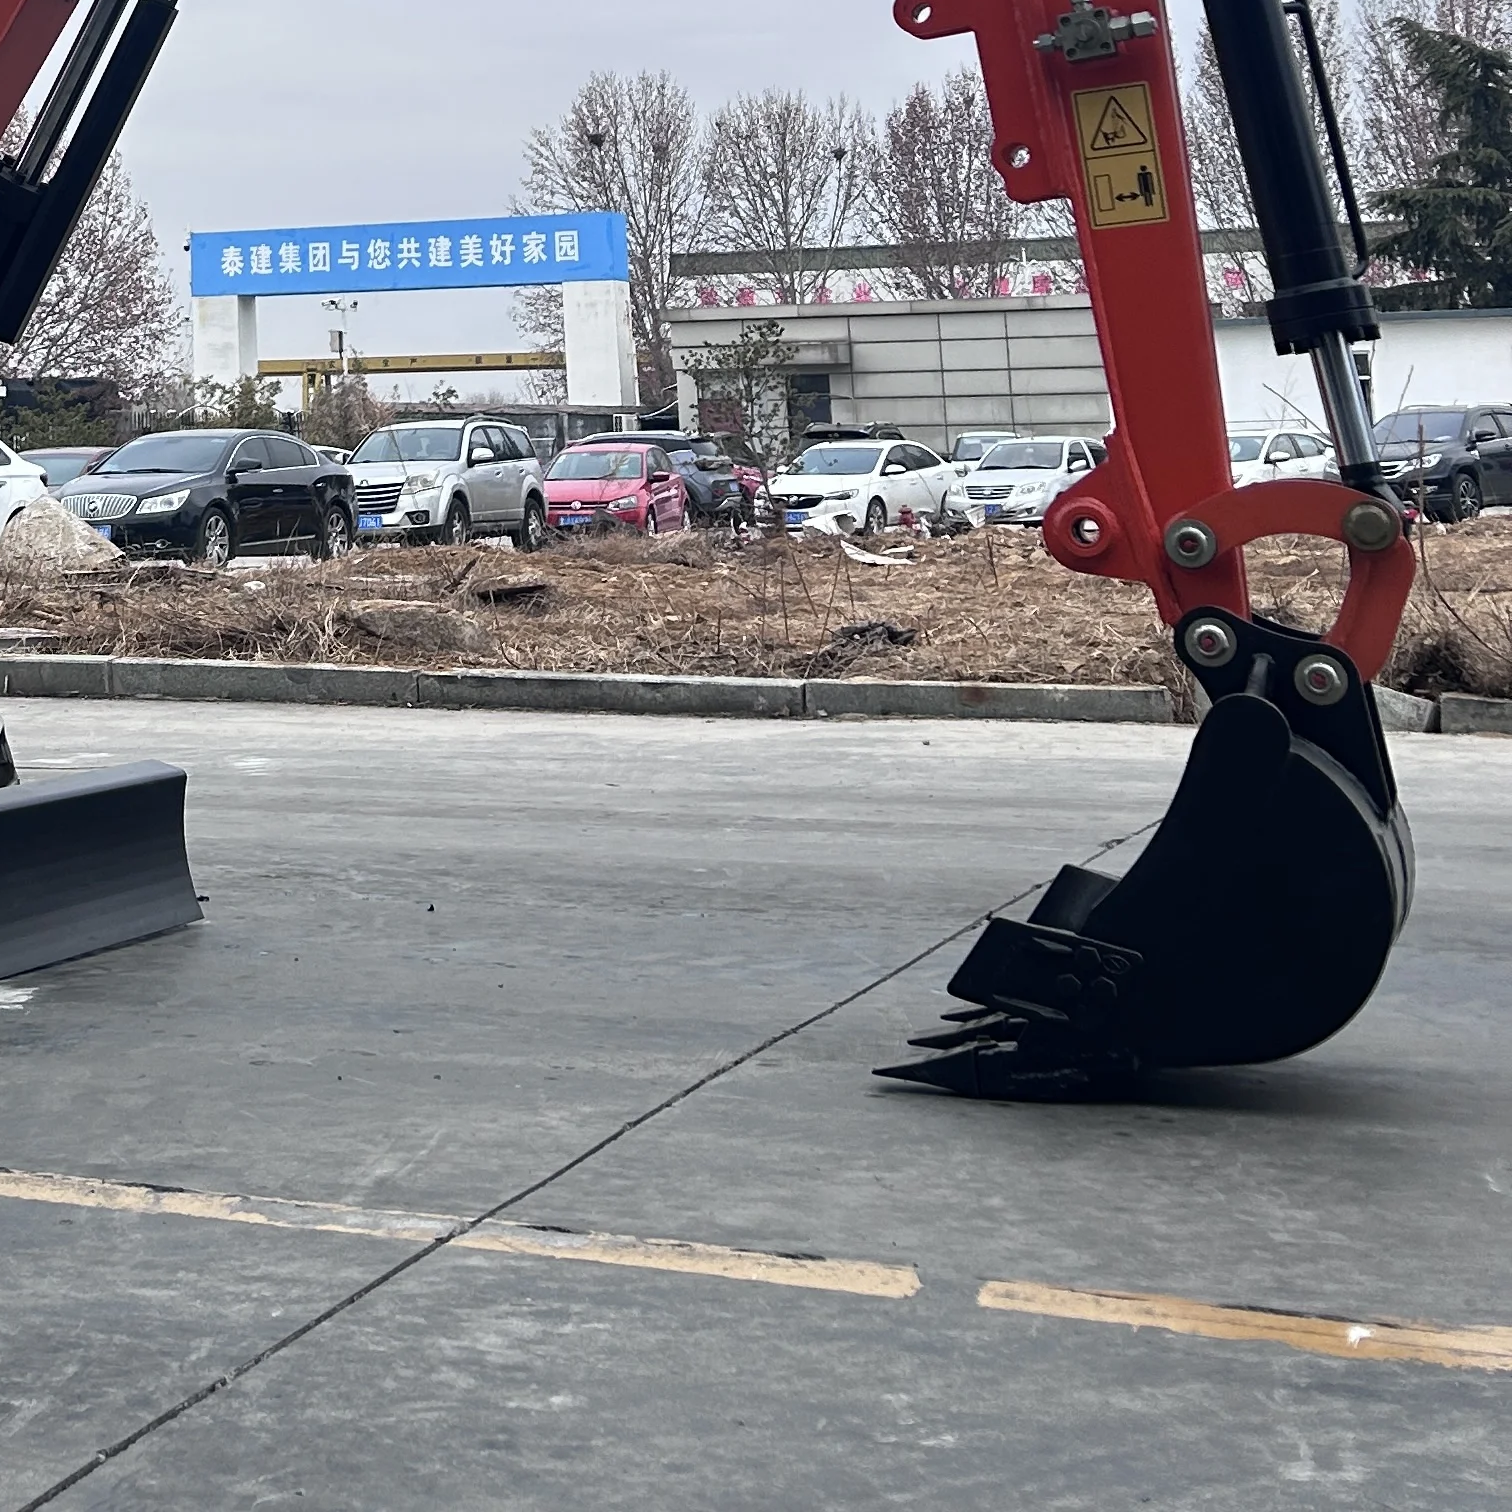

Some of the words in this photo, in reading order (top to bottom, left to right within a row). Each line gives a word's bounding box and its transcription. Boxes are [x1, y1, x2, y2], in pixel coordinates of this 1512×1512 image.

[221, 230, 580, 276] 泰建集团与您共建美好家园
